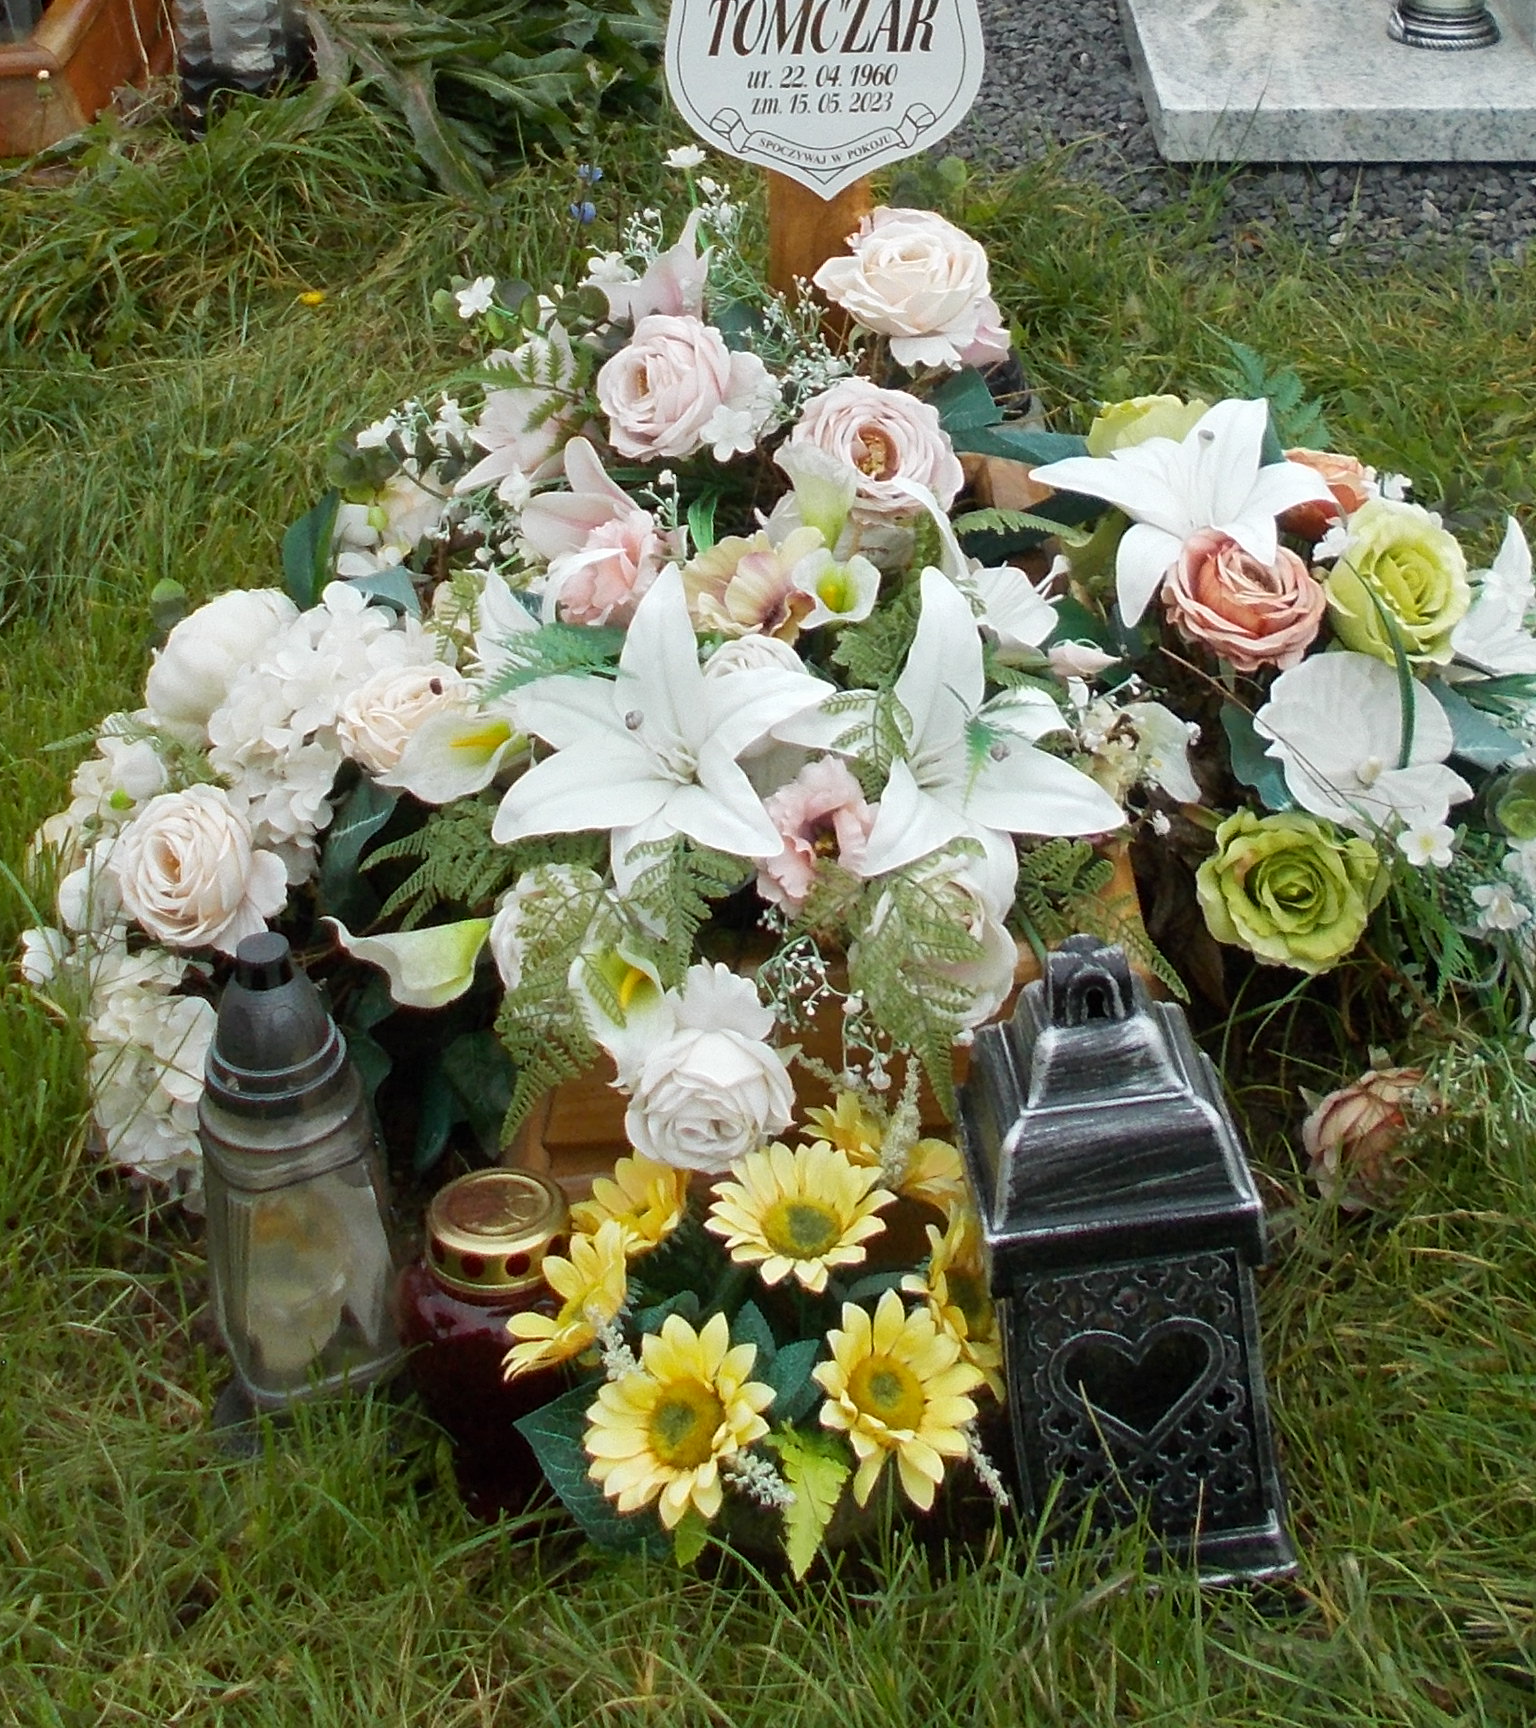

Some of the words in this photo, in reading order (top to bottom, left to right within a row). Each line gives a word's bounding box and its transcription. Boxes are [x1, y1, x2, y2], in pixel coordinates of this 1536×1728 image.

[746, 69, 774, 90] ur.
[779, 65, 809, 90] 22.
[814, 63, 843, 89] 04.
[849, 62, 900, 89] 1960
[751, 96, 783, 116] zm.
[788, 92, 812, 115] 15.
[817, 92, 843, 114] 05.
[848, 91, 895, 114] 2023
[757, 136, 827, 165] SPOCZYWAJ
[831, 154, 843, 165] W
[846, 132, 894, 161] POKOJU
